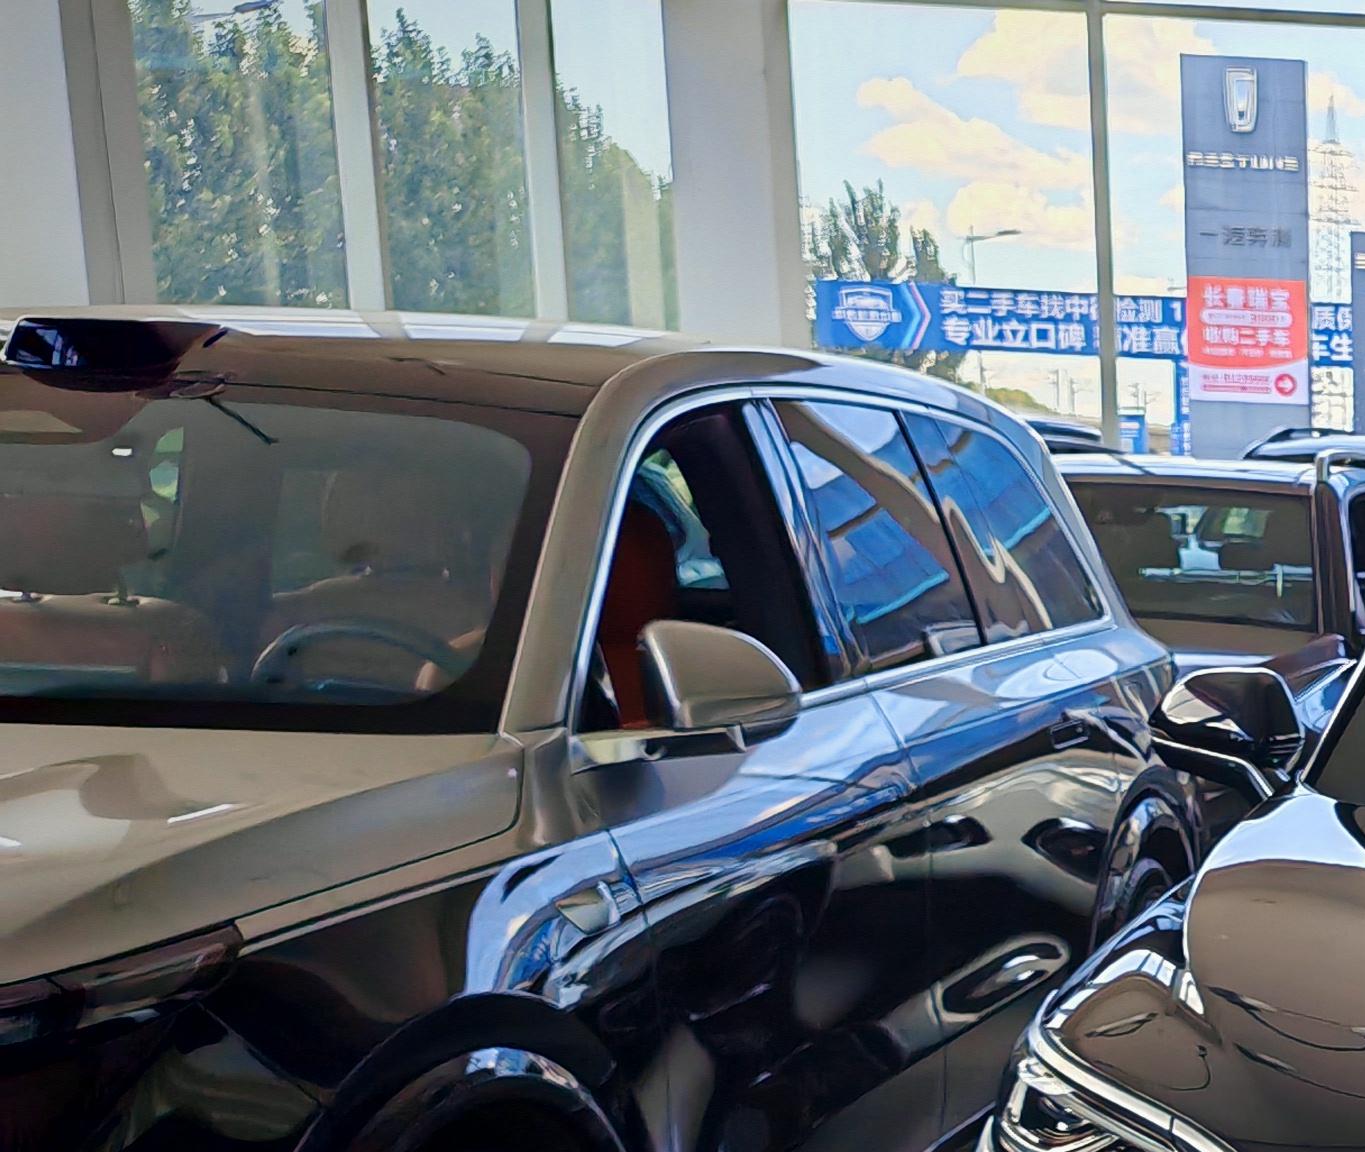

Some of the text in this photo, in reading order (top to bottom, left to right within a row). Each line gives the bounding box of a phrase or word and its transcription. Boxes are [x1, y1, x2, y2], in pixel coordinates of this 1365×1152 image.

[943, 316, 1088, 350] 专业立口碑
